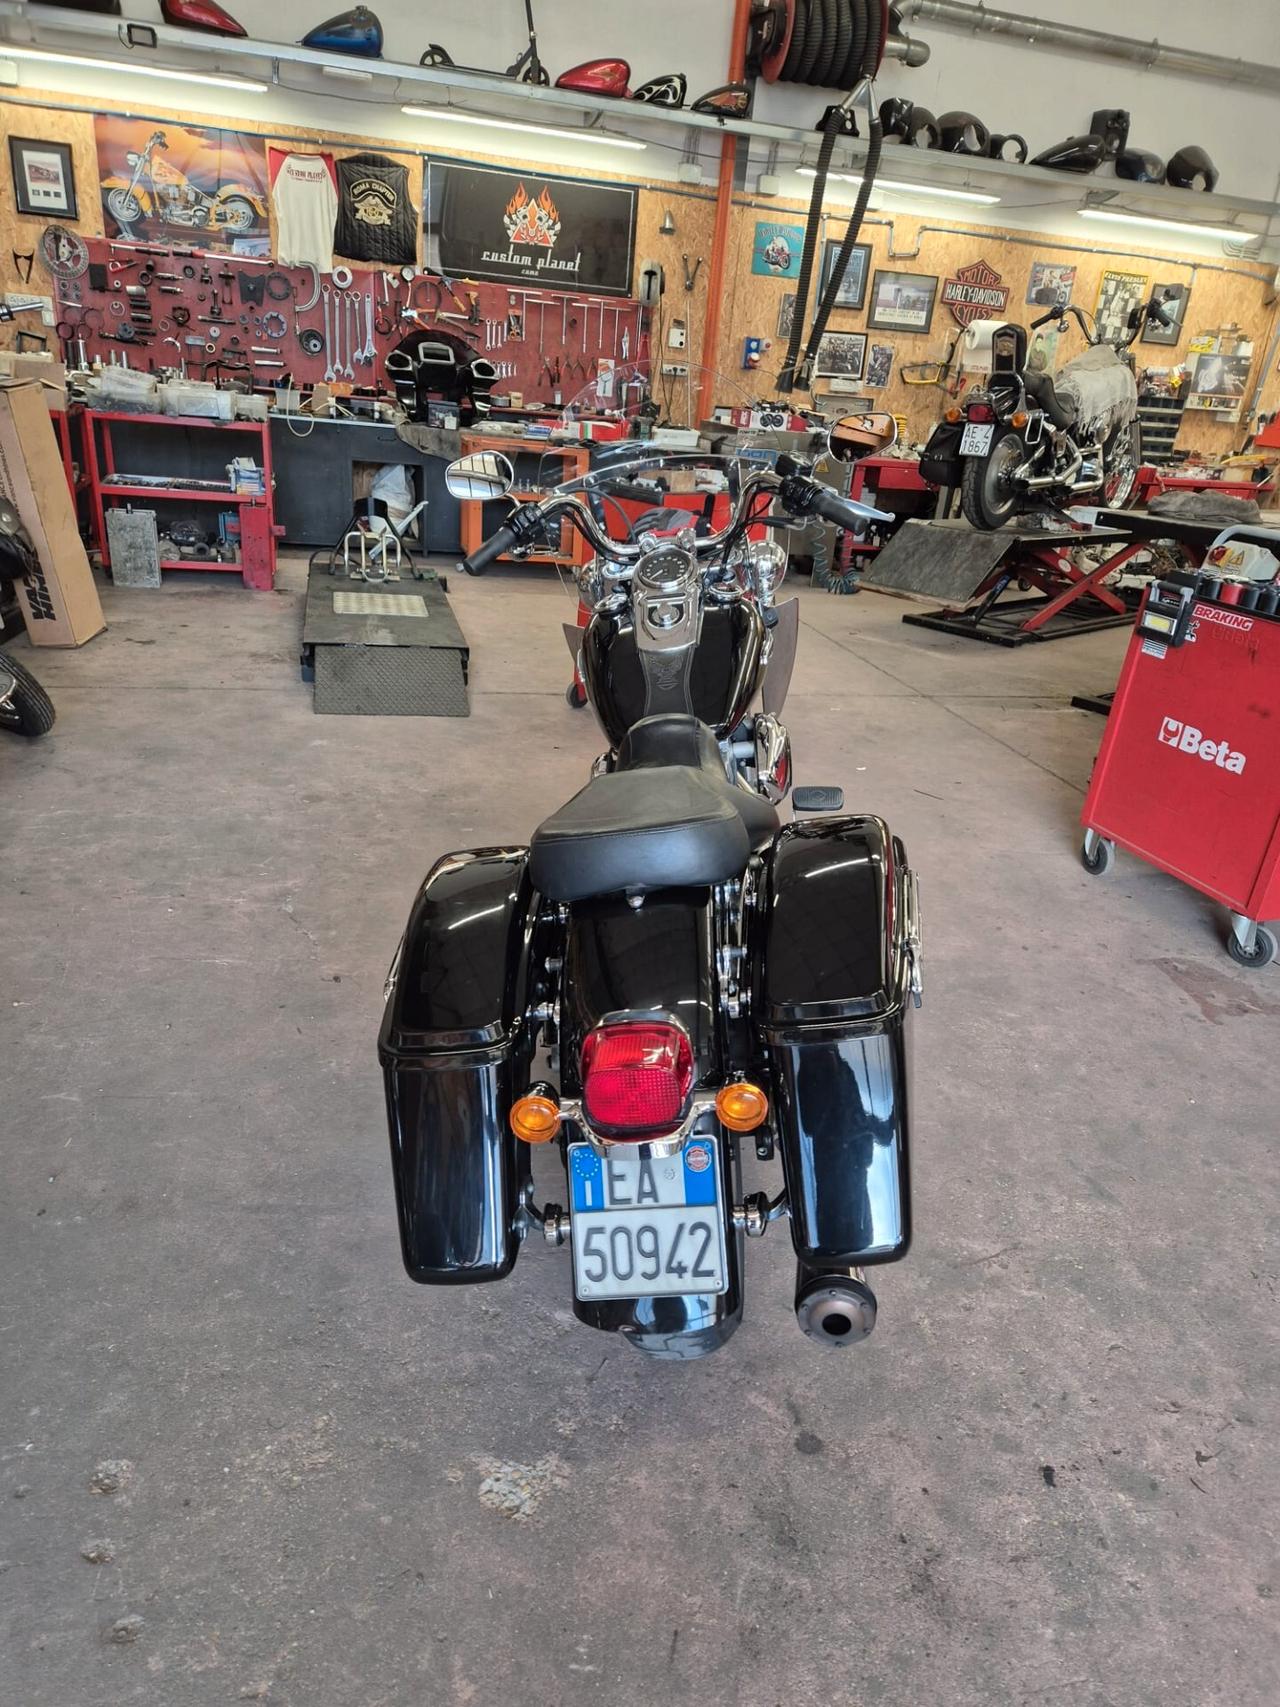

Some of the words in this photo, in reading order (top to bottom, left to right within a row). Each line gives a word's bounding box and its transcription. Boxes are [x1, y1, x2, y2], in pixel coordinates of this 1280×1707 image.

[352, 182, 370, 195] ROMA
[480, 244, 532, 266] custom
[536, 249, 581, 271] planet
[963, 264, 997, 287] MOTOR
[945, 283, 1007, 307] HARLEY-DAVIDSON
[1195, 604, 1254, 630] BRAKING
[1178, 726, 1247, 774] Beta
[608, 1158, 659, 1205] EA
[583, 1221, 715, 1283] 50942
